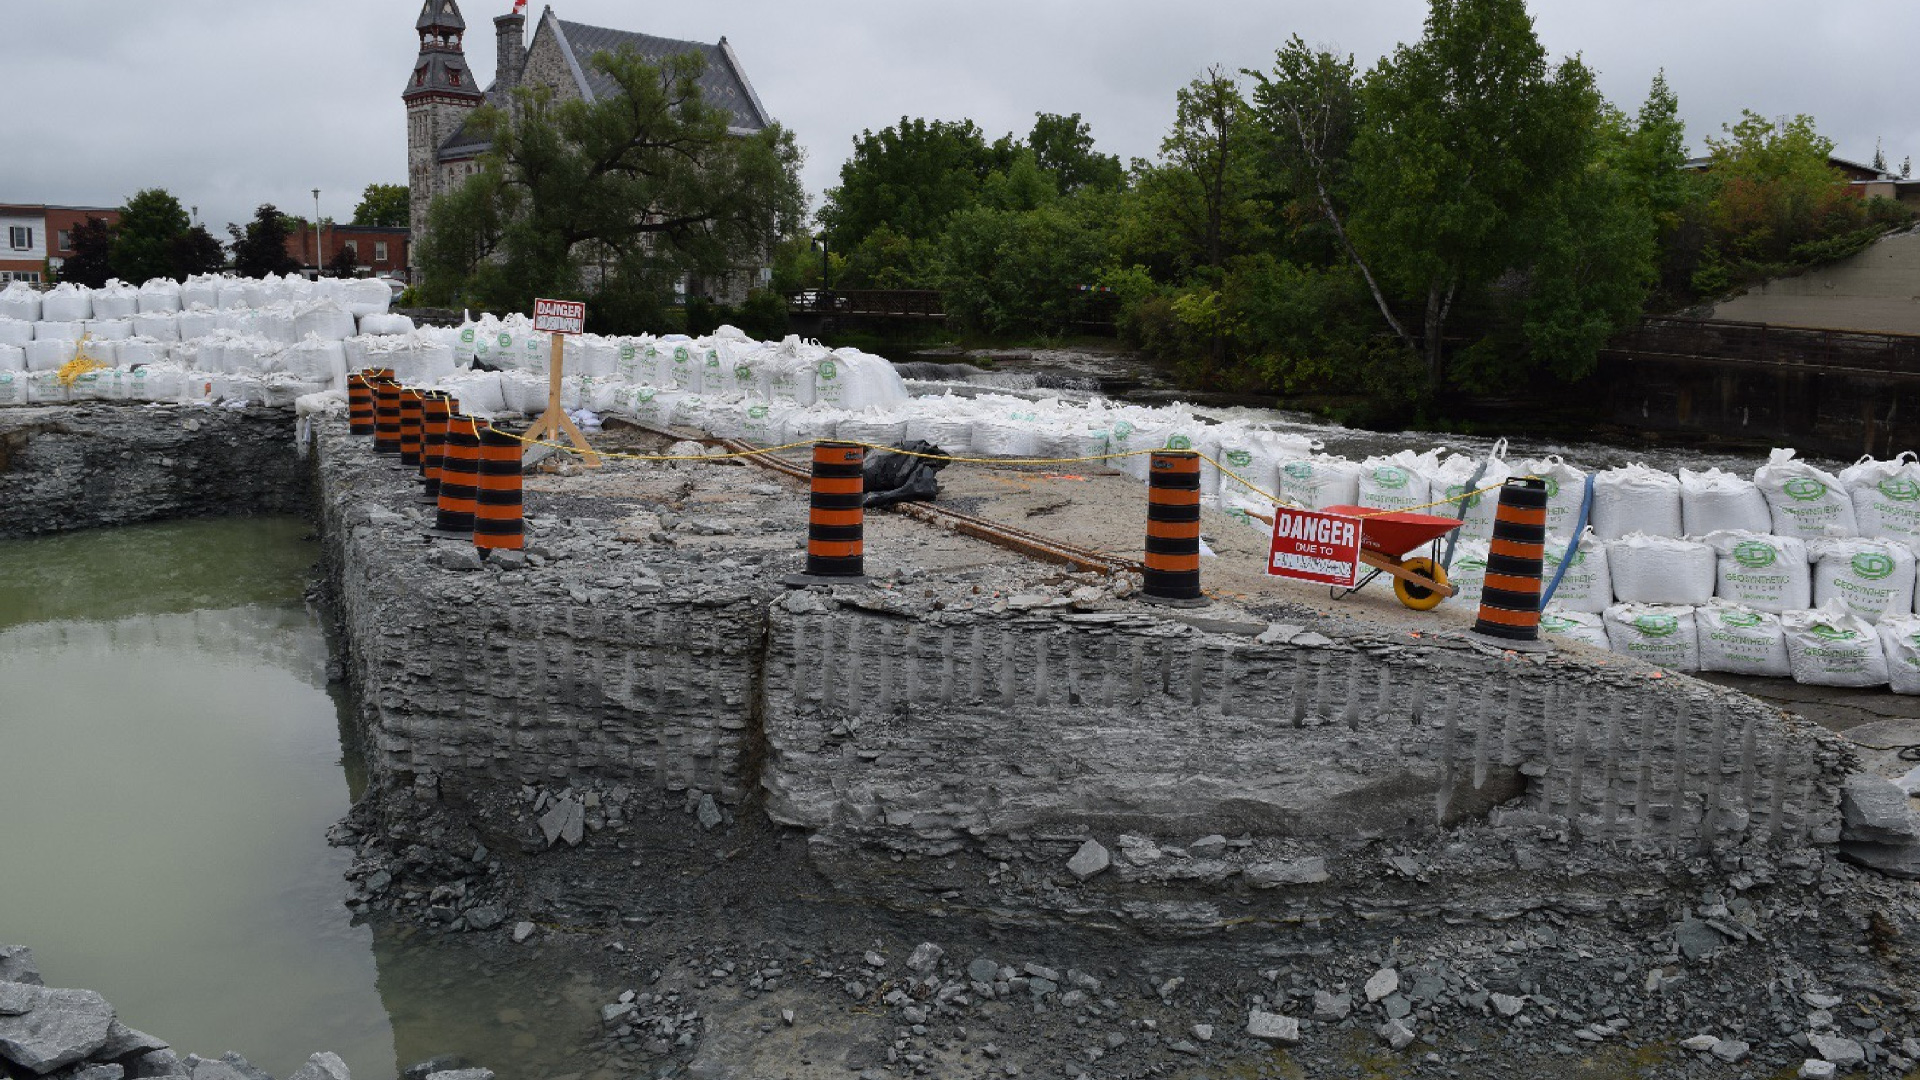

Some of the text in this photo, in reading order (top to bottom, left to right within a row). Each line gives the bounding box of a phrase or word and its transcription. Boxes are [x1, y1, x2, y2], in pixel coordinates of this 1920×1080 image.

[537, 301, 581, 318] DANGER
[1873, 503, 1920, 519] GEOSYNTHE
[1278, 512, 1355, 548] DANGER
[1295, 542, 1334, 555] DUE TO
[1724, 573, 1790, 585] GEOSYNTHETIC
[1833, 578, 1899, 598] GEOSYNTHET
[1711, 632, 1776, 646] GEOSYNTHETIC
